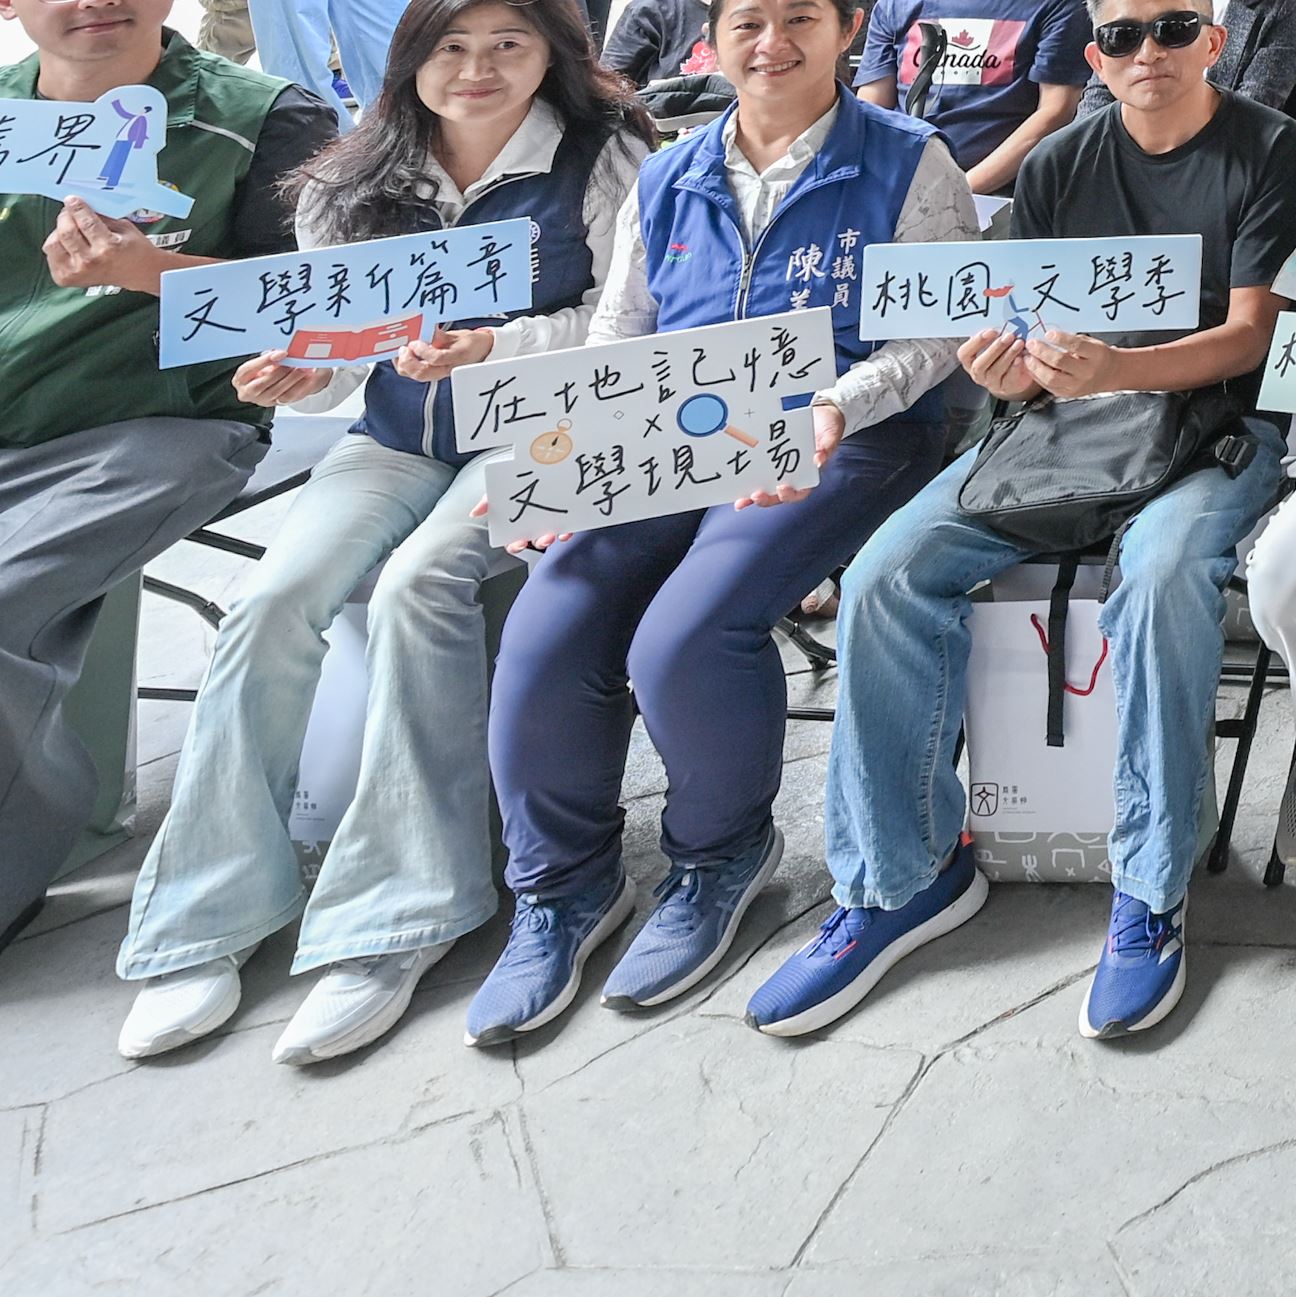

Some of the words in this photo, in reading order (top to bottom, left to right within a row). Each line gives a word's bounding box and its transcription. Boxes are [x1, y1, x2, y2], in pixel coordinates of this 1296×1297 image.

[182, 236, 515, 342] 文學新篇章
[832, 227, 862, 308] 市議員
[470, 326, 822, 441] 在地記憶
[508, 419, 800, 523] 文學現場
